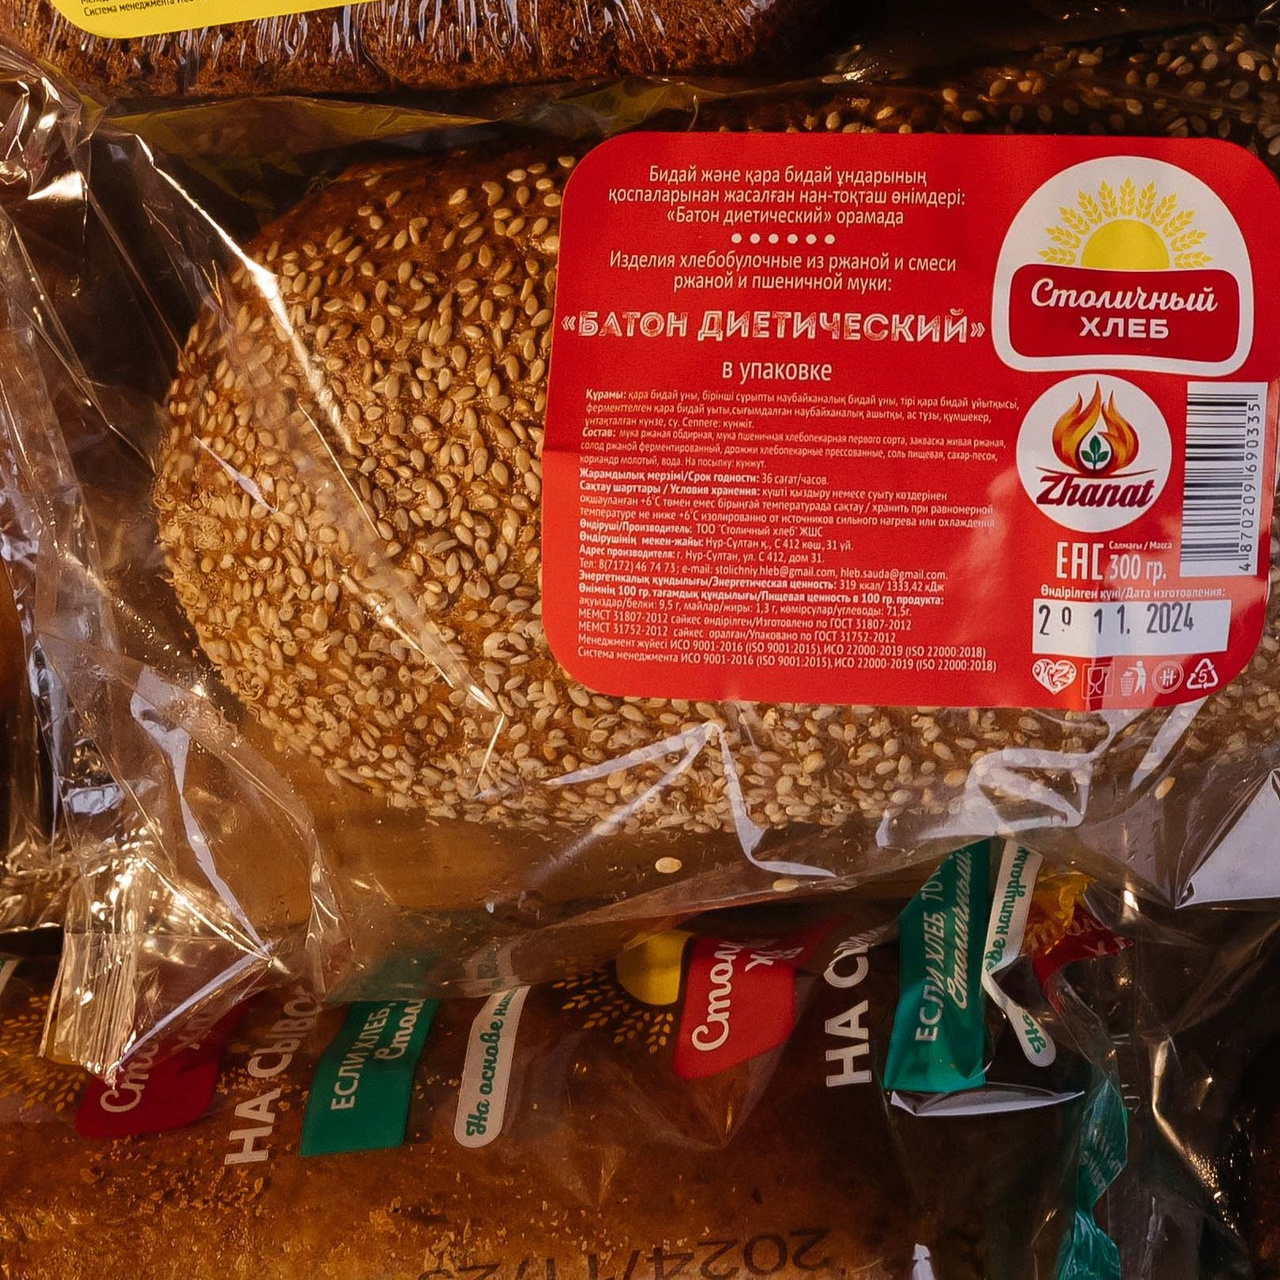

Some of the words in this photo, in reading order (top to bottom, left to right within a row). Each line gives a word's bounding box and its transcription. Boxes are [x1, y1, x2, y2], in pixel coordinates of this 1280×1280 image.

[648, 163, 698, 186] Бидай
[699, 168, 742, 183] және
[744, 168, 781, 187] қара
[783, 163, 833, 187] бидай
[835, 169, 928, 188] ұндарының
[1030, 277, 1218, 312] Столичный
[559, 309, 689, 338] «БАТОН
[696, 306, 986, 344] ДИЕТИЧЕСКИЙ»
[1078, 315, 1169, 339] ХЛЕБ
[721, 360, 734, 380] в
[738, 360, 833, 386] упаковке
[1034, 471, 1157, 510] Zhanat
[1107, 552, 1144, 582] 300
[1144, 559, 1169, 588] гр.
[1145, 600, 1195, 634] 2024
[912, 962, 948, 1044] ЕСЛИ
[473, 1015, 504, 1096] основе
[817, 994, 880, 1092] НА
[329, 1048, 372, 1113] ЕСЛИ
[223, 1081, 283, 1170] НА
[463, 1096, 491, 1139] На
